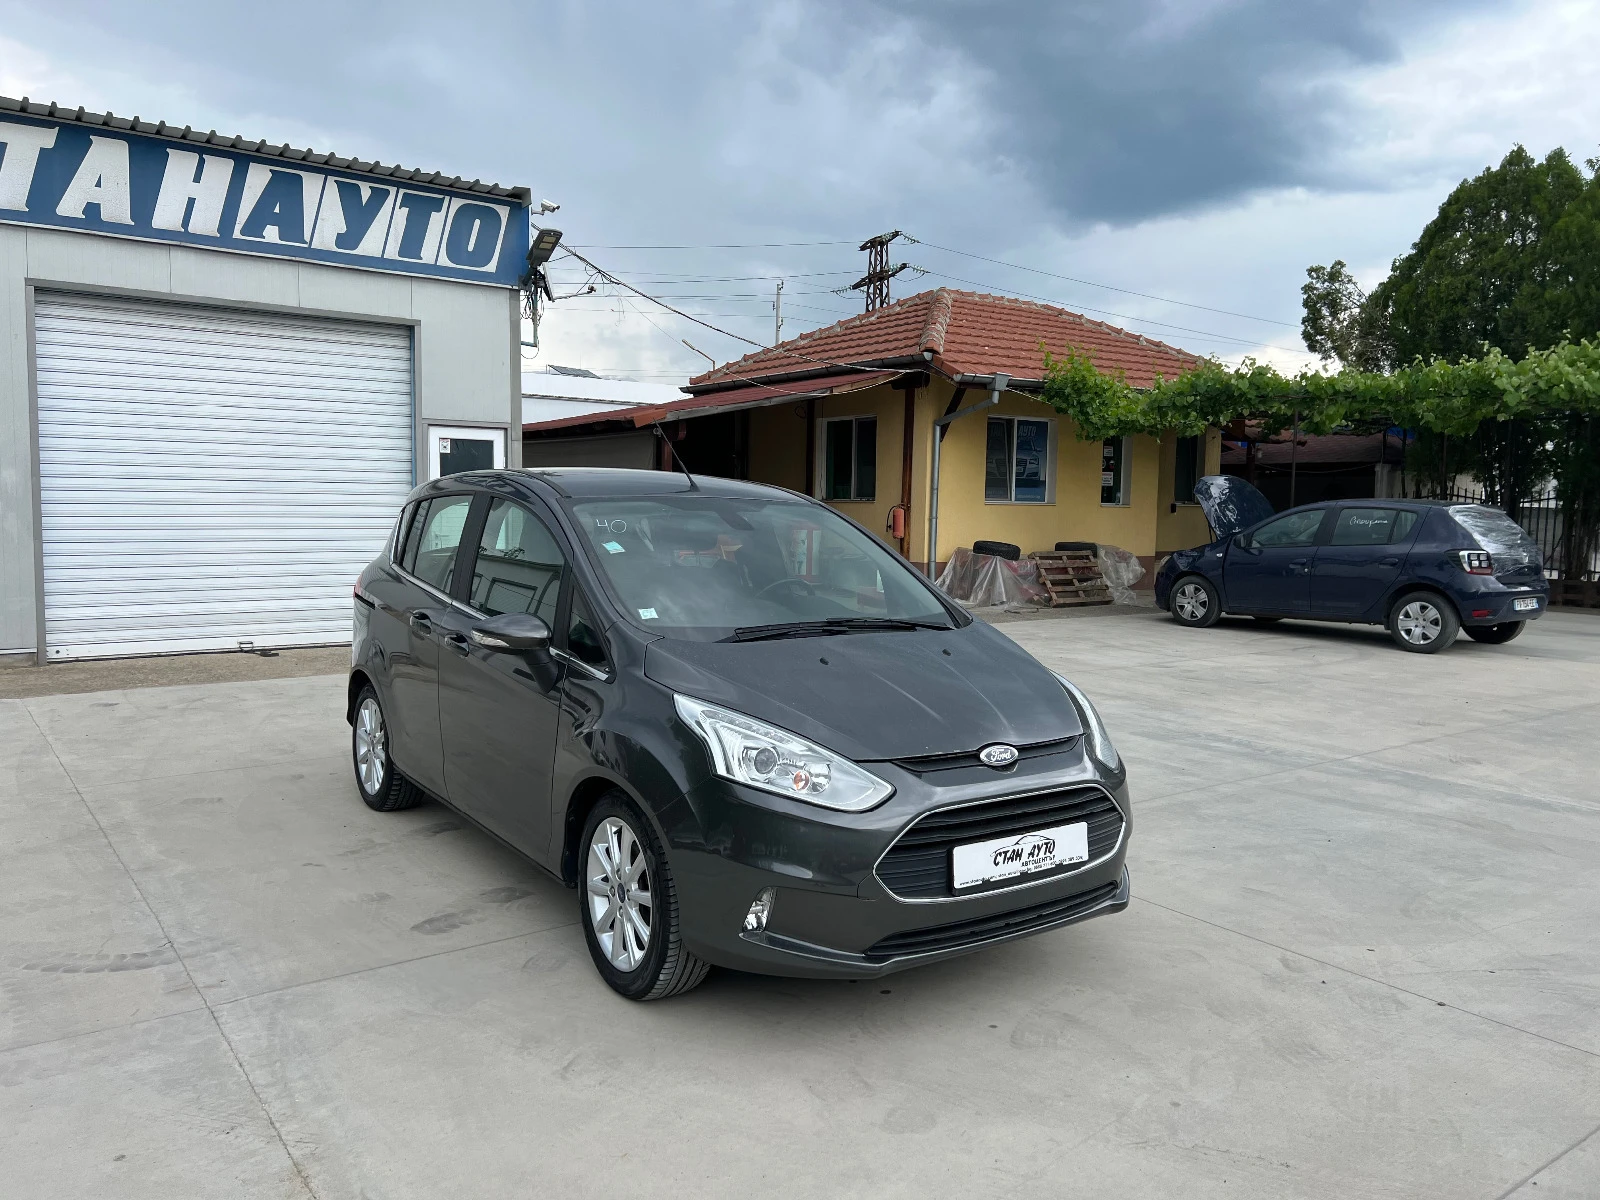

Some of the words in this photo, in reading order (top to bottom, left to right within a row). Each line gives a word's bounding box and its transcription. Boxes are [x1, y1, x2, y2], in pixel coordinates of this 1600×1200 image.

[596, 519, 627, 534] 40
[990, 748, 1012, 761] Ford
[993, 847, 1024, 867] СТАН
[1027, 840, 1056, 860] АУТО
